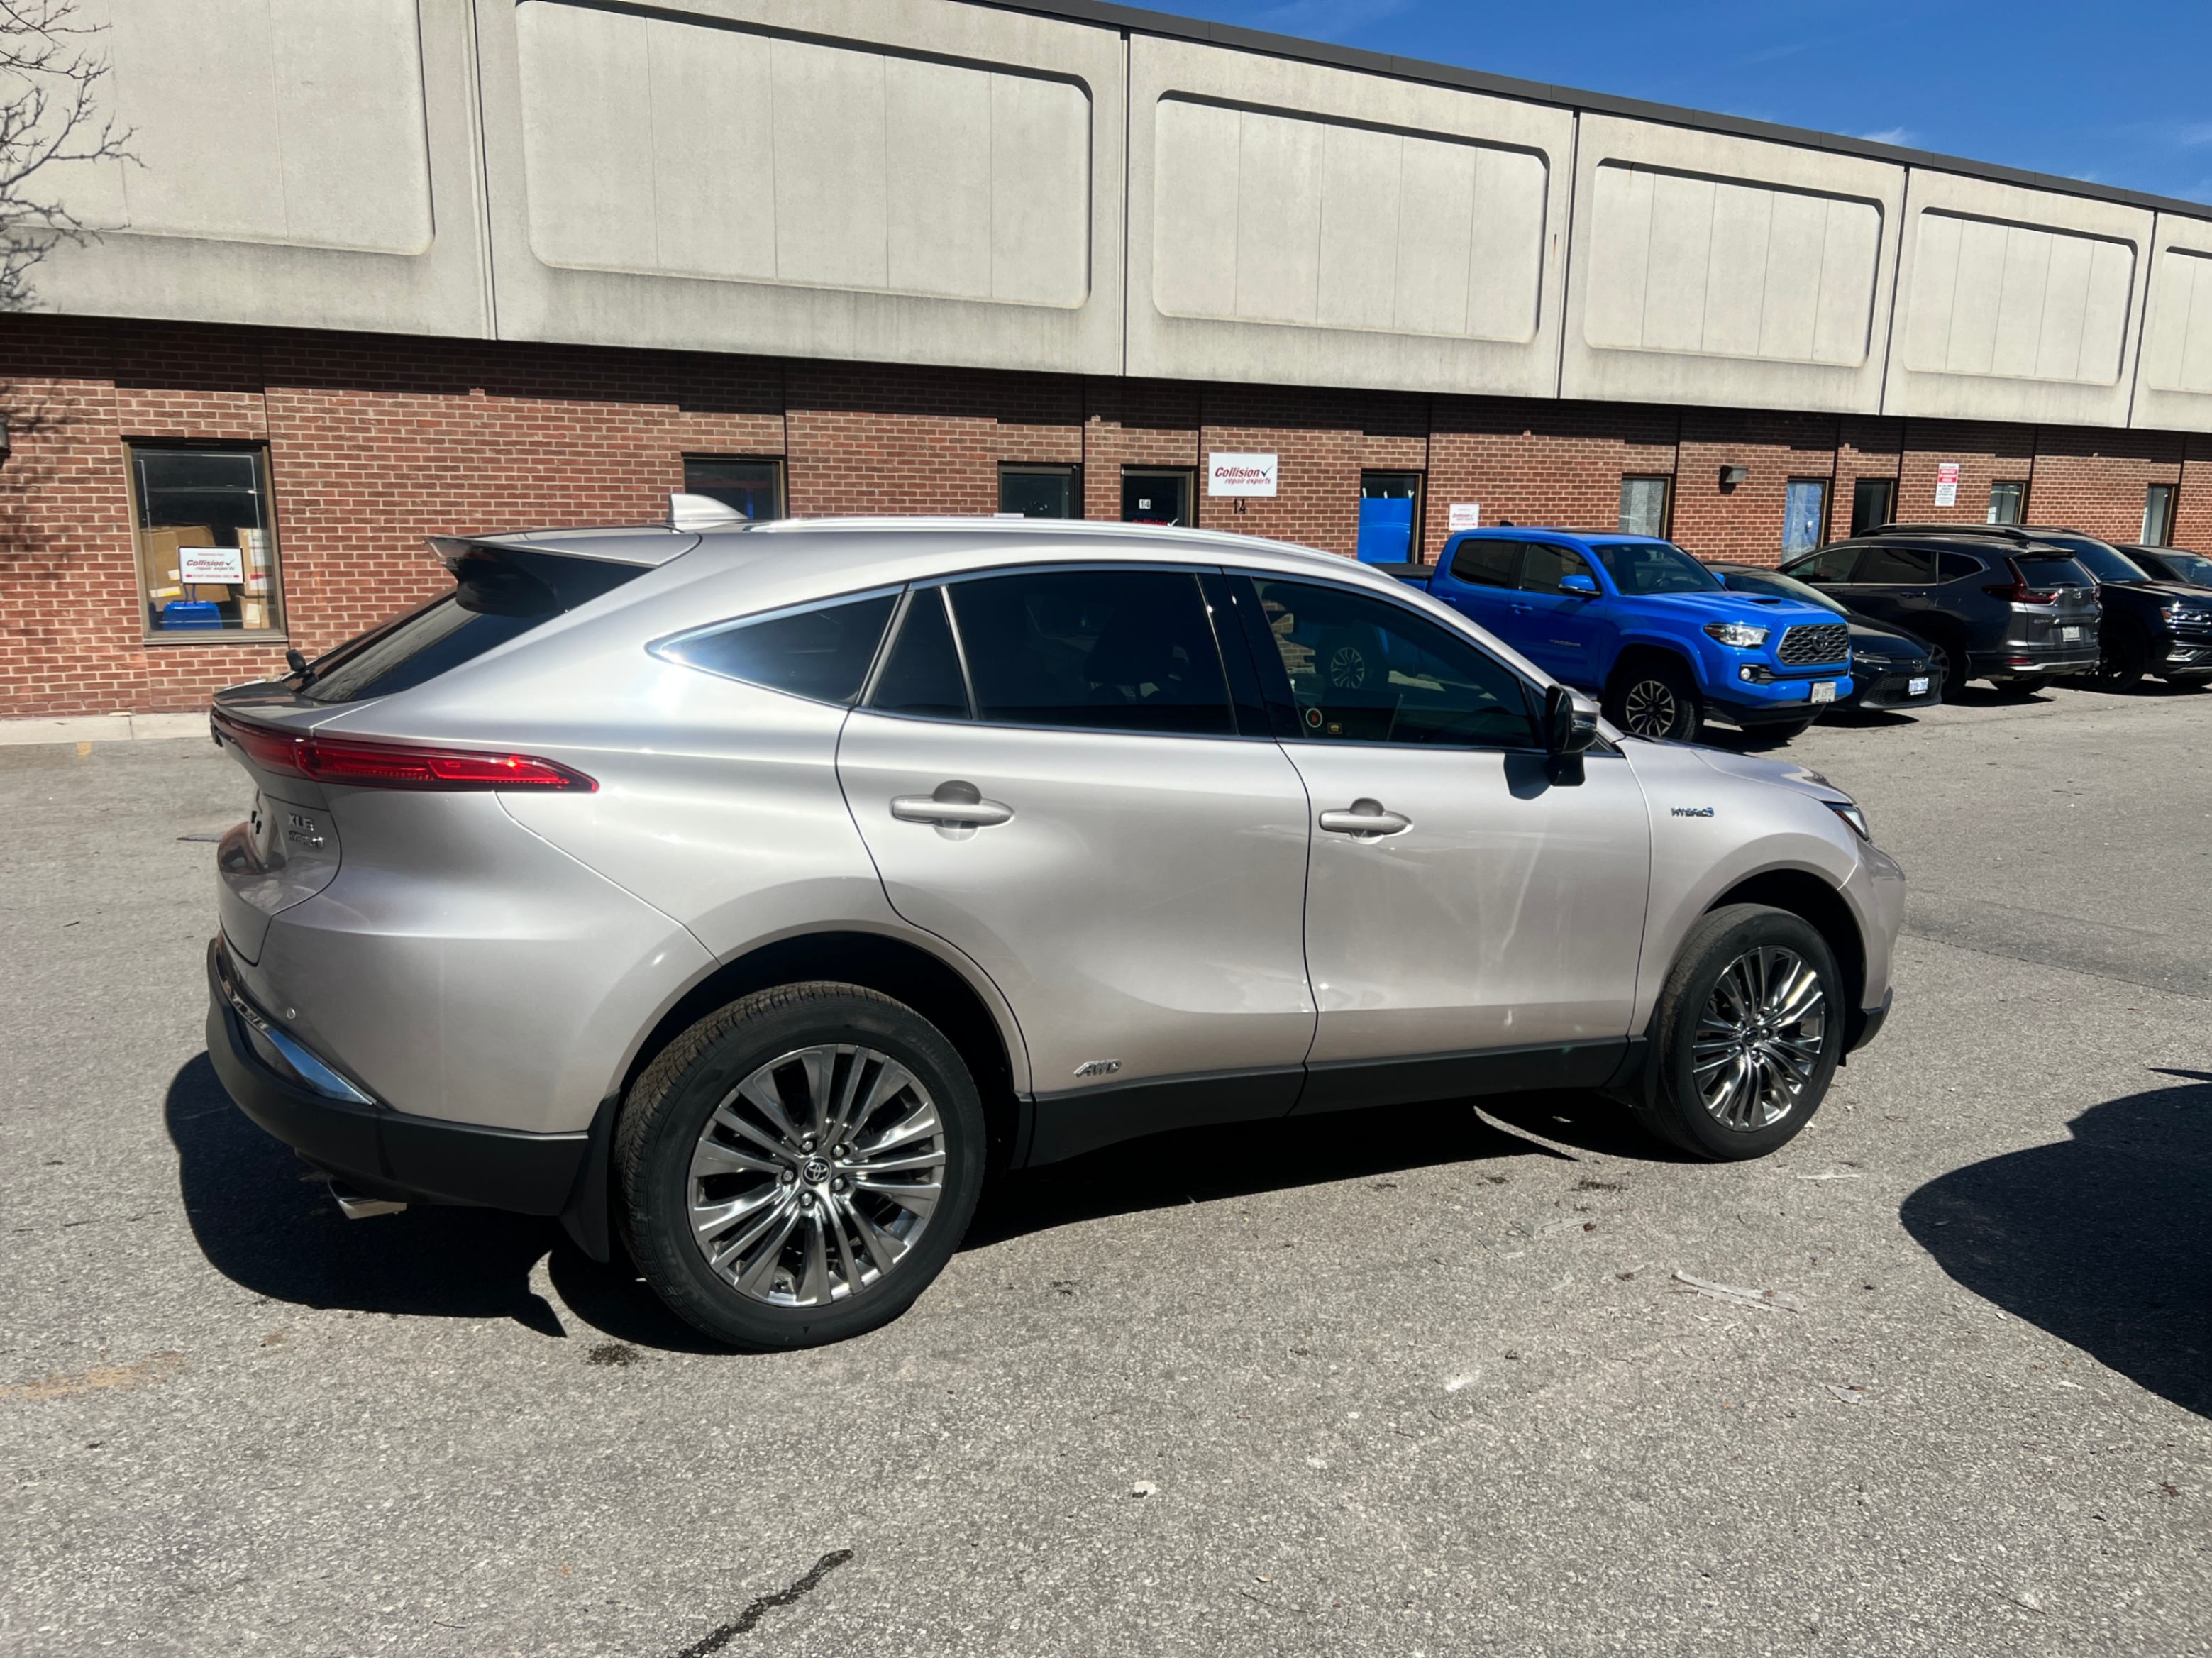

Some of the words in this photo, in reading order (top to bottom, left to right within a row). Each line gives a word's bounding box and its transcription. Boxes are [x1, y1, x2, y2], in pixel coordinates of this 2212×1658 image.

[1215, 466, 1260, 477] Collision
[1139, 499, 1150, 509] 14
[1233, 498, 1246, 514] 14
[288, 813, 314, 831] XLE
